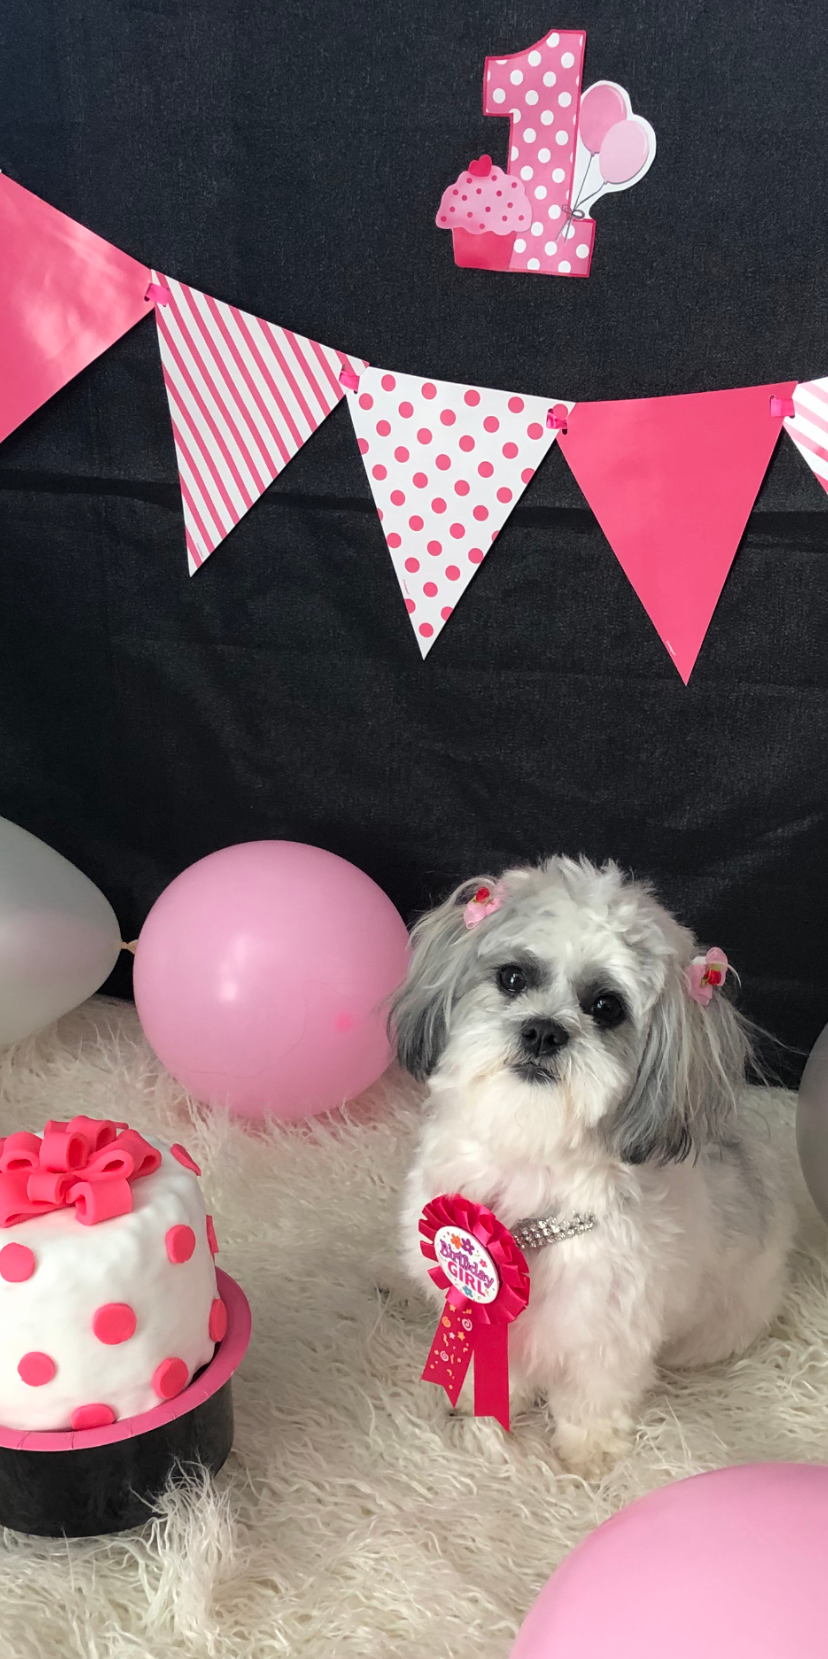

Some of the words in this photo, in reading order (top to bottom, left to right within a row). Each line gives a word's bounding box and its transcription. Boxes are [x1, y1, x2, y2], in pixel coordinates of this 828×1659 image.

[483, 29, 596, 278] 1
[439, 1239, 494, 1289] Birthday
[448, 1261, 486, 1297] GIRL
